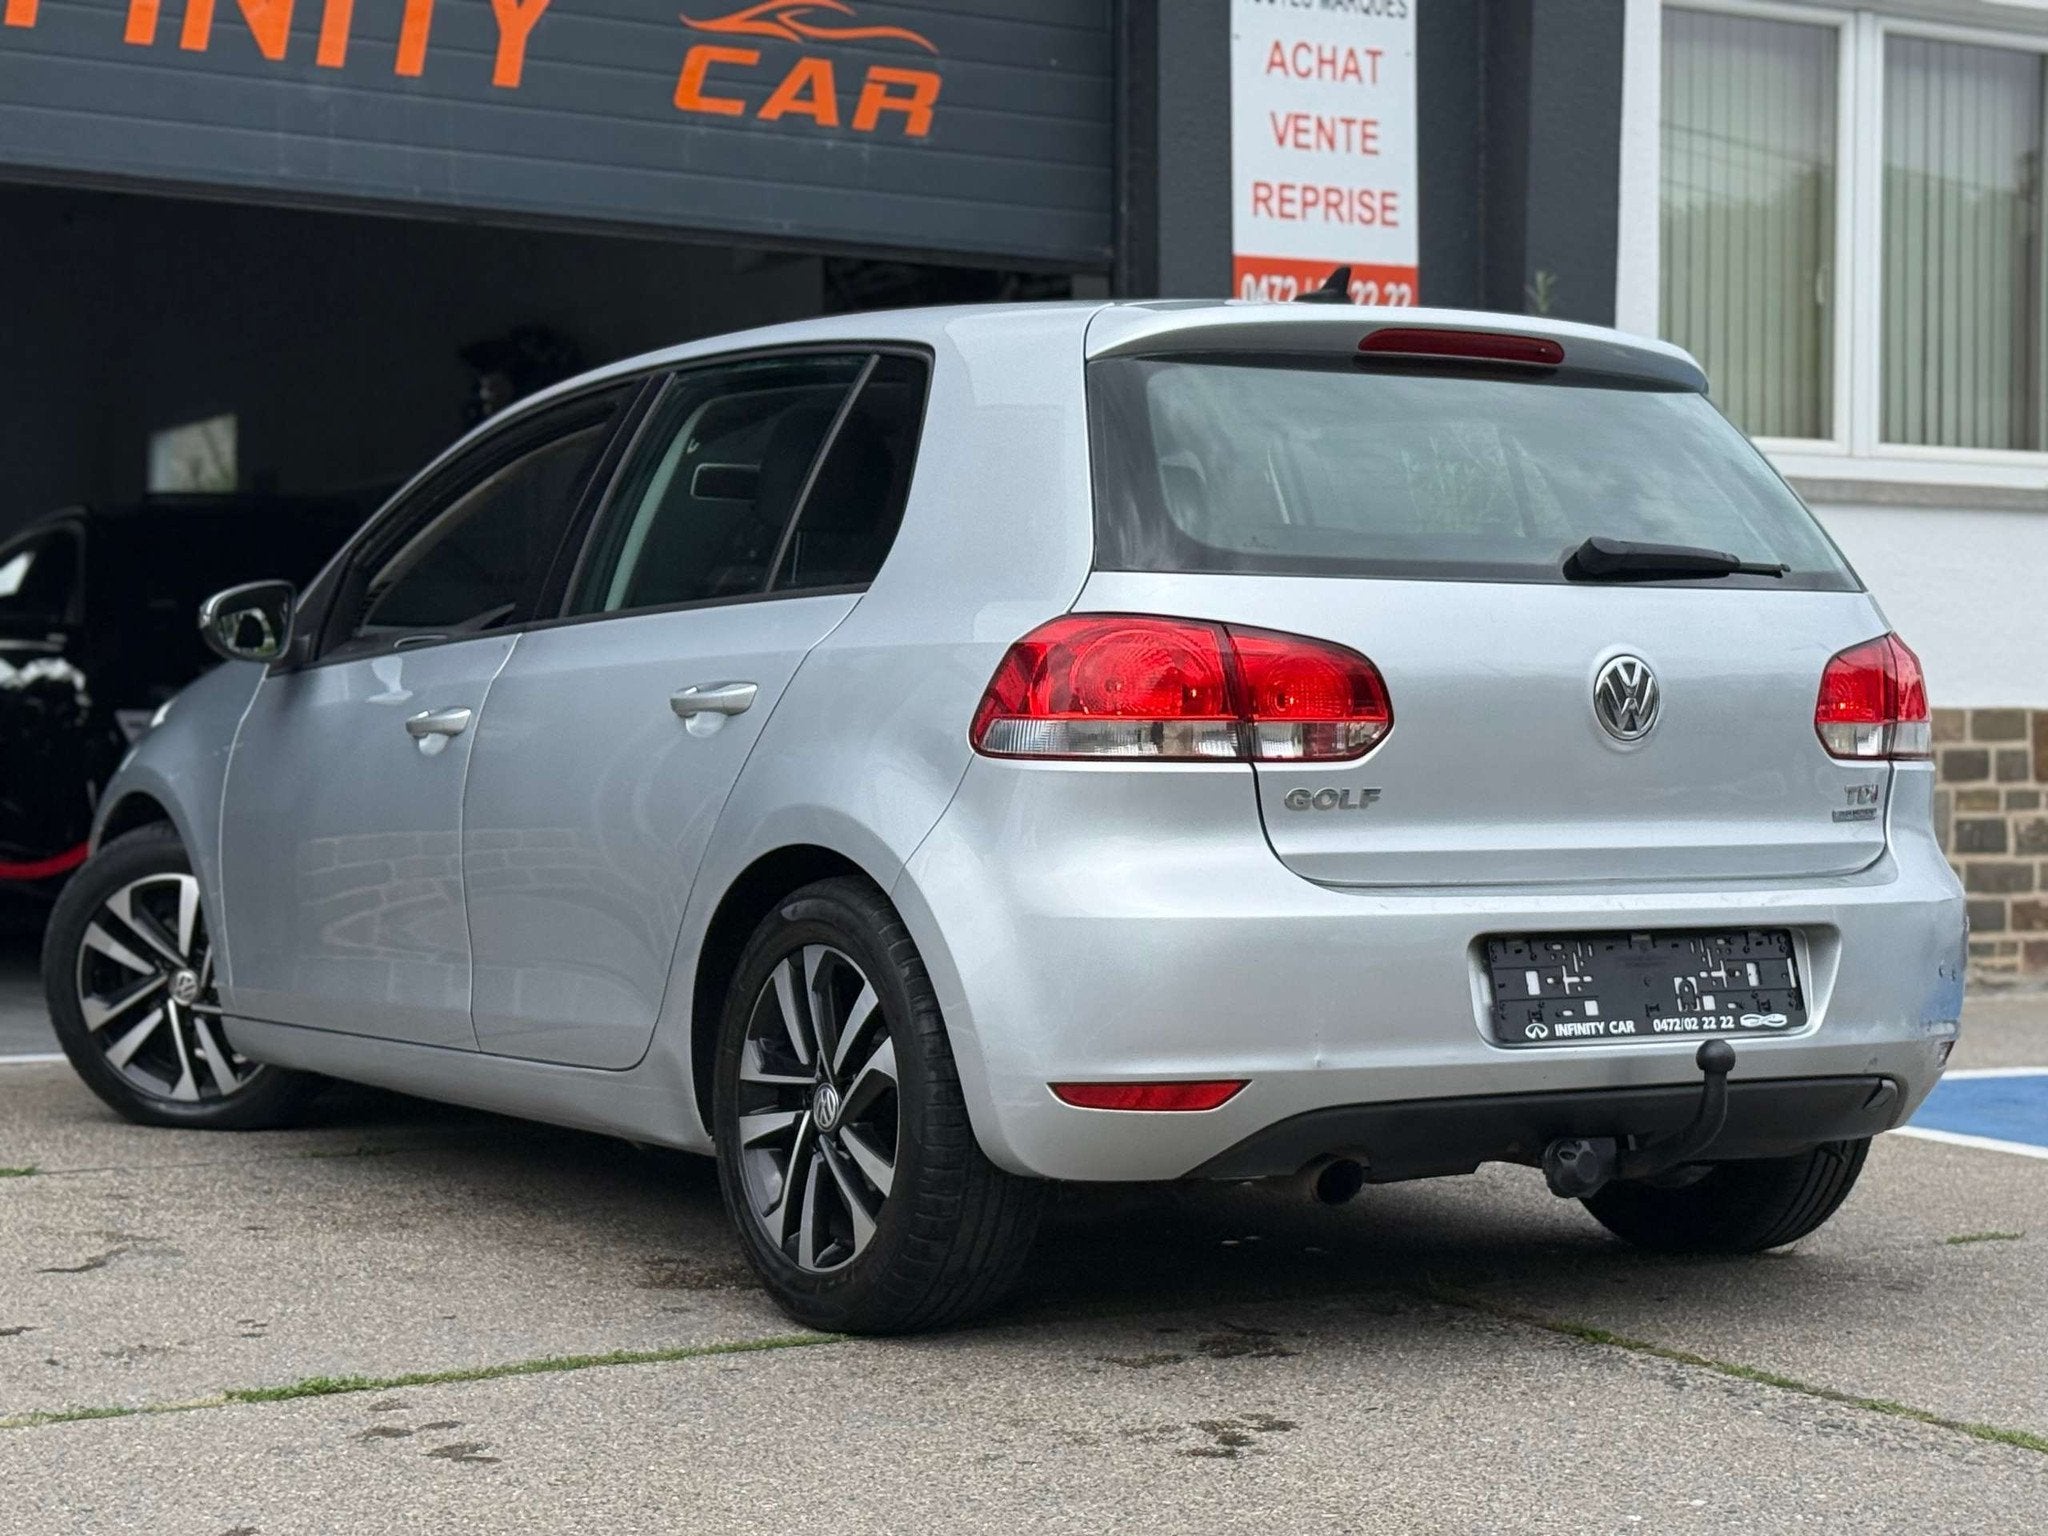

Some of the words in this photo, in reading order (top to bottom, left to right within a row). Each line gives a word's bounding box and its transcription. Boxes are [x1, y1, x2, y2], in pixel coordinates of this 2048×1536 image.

[1266, 39, 1384, 84] ACHAT
[674, 44, 942, 137] CAR
[1270, 111, 1380, 156] VENTE
[1253, 180, 1400, 228] REPRISE
[1284, 787, 1382, 811] GOLF
[1554, 1021, 1605, 1037] INFINITY
[1609, 1020, 1636, 1034] CAR
[1653, 1017, 1699, 1032] 0472/02
[1701, 1016, 1717, 1030] 22
[1720, 1016, 1735, 1029] 22
